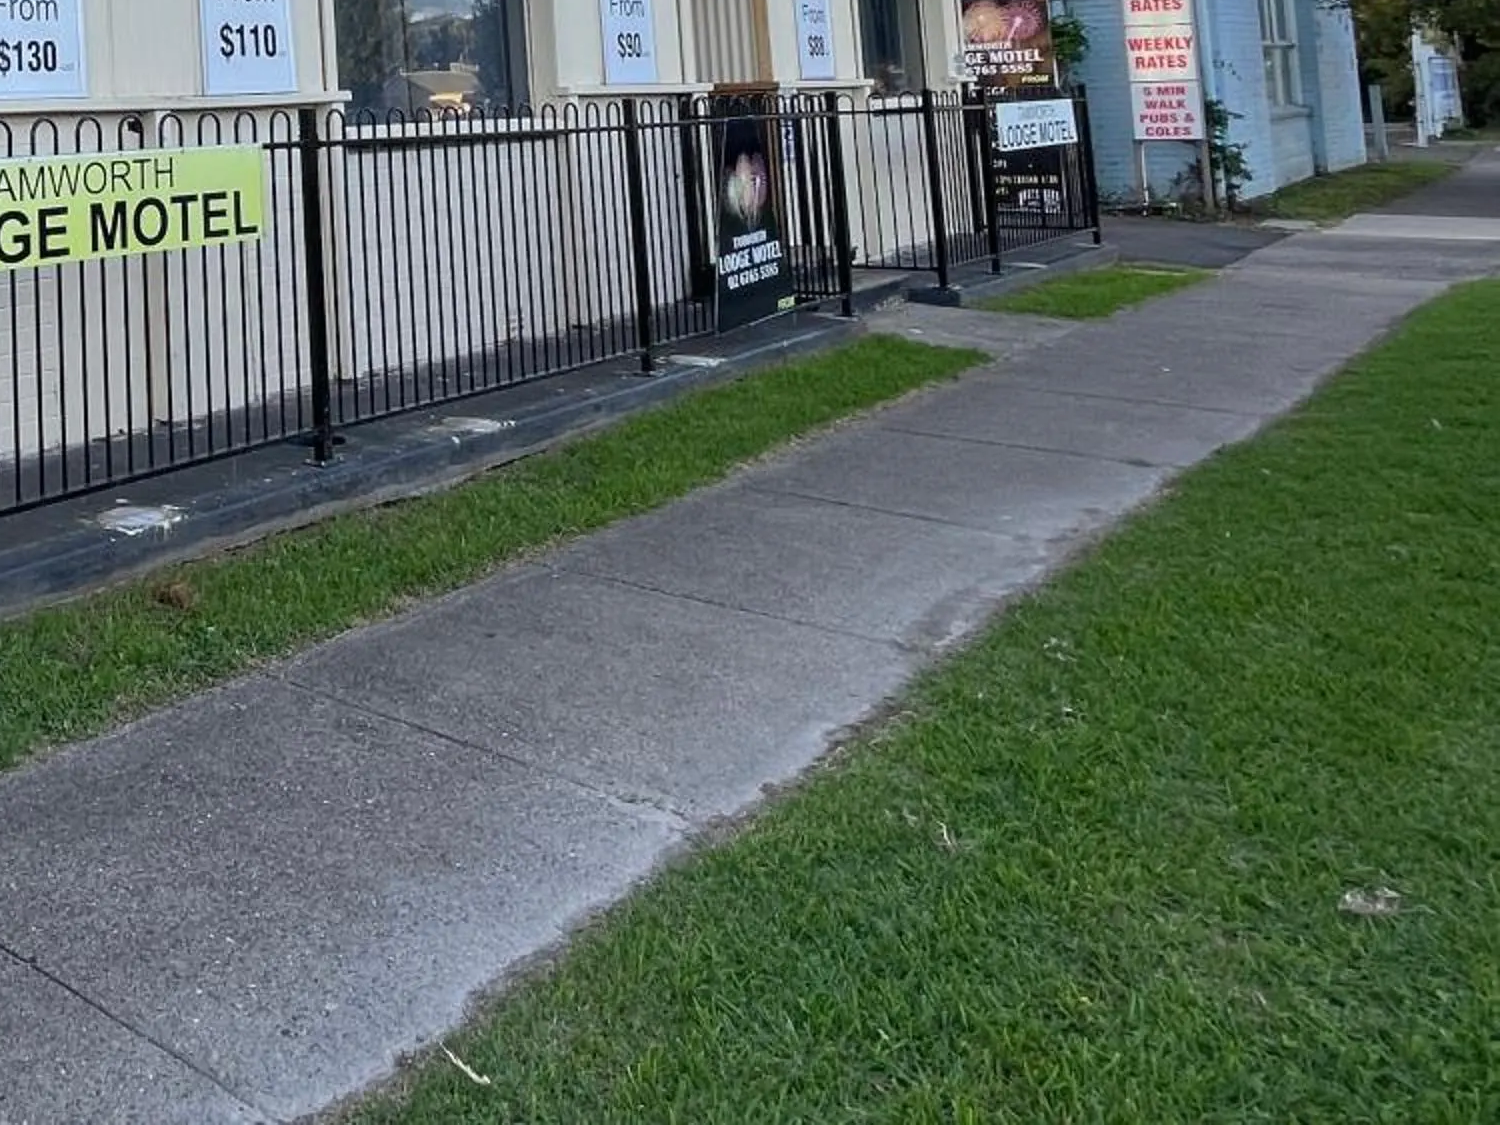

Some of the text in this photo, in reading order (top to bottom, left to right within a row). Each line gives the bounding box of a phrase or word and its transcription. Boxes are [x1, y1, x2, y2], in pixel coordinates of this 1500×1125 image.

[220, 23, 277, 63] $110
[617, 32, 642, 63] $90
[1127, 35, 1193, 52] WEEKLY
[989, 49, 1044, 64] MOTEL
[1135, 54, 1187, 70] RATES
[1156, 86, 1186, 96] MIN
[1144, 99, 1187, 110] WALK
[1140, 113, 1179, 124] PUBS
[1000, 120, 1075, 148] LODGE MOTEL
[1145, 126, 1192, 138] COLES
[90, 190, 258, 252] MOTEL
